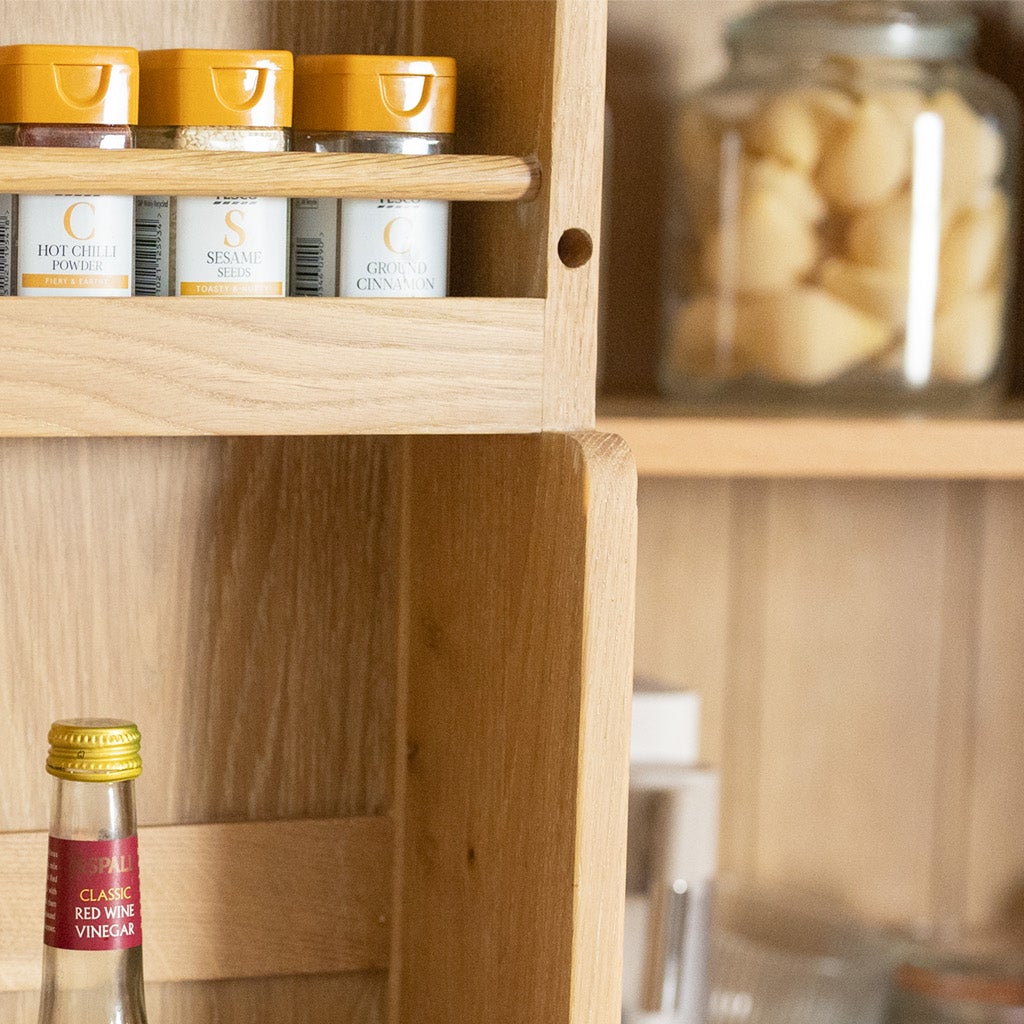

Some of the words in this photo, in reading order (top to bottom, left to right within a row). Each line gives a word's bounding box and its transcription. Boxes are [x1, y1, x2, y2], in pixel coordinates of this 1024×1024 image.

[63, 201, 96, 241] C
[223, 209, 246, 248] S
[38, 244, 68, 257] HOT
[71, 244, 117, 258] CHILLI
[206, 250, 263, 265] SESAME
[52, 259, 103, 271] POWDER
[366, 261, 427, 274] GROUND
[217, 267, 251, 278] SEEDS
[195, 285, 229, 293] TOASTY
[356, 277, 435, 291] CINNAMON
[79, 886, 132, 902] CLASSIC
[75, 906, 101, 920] RED
[104, 903, 135, 920] WINE
[74, 922, 135, 938] VINEGAR
